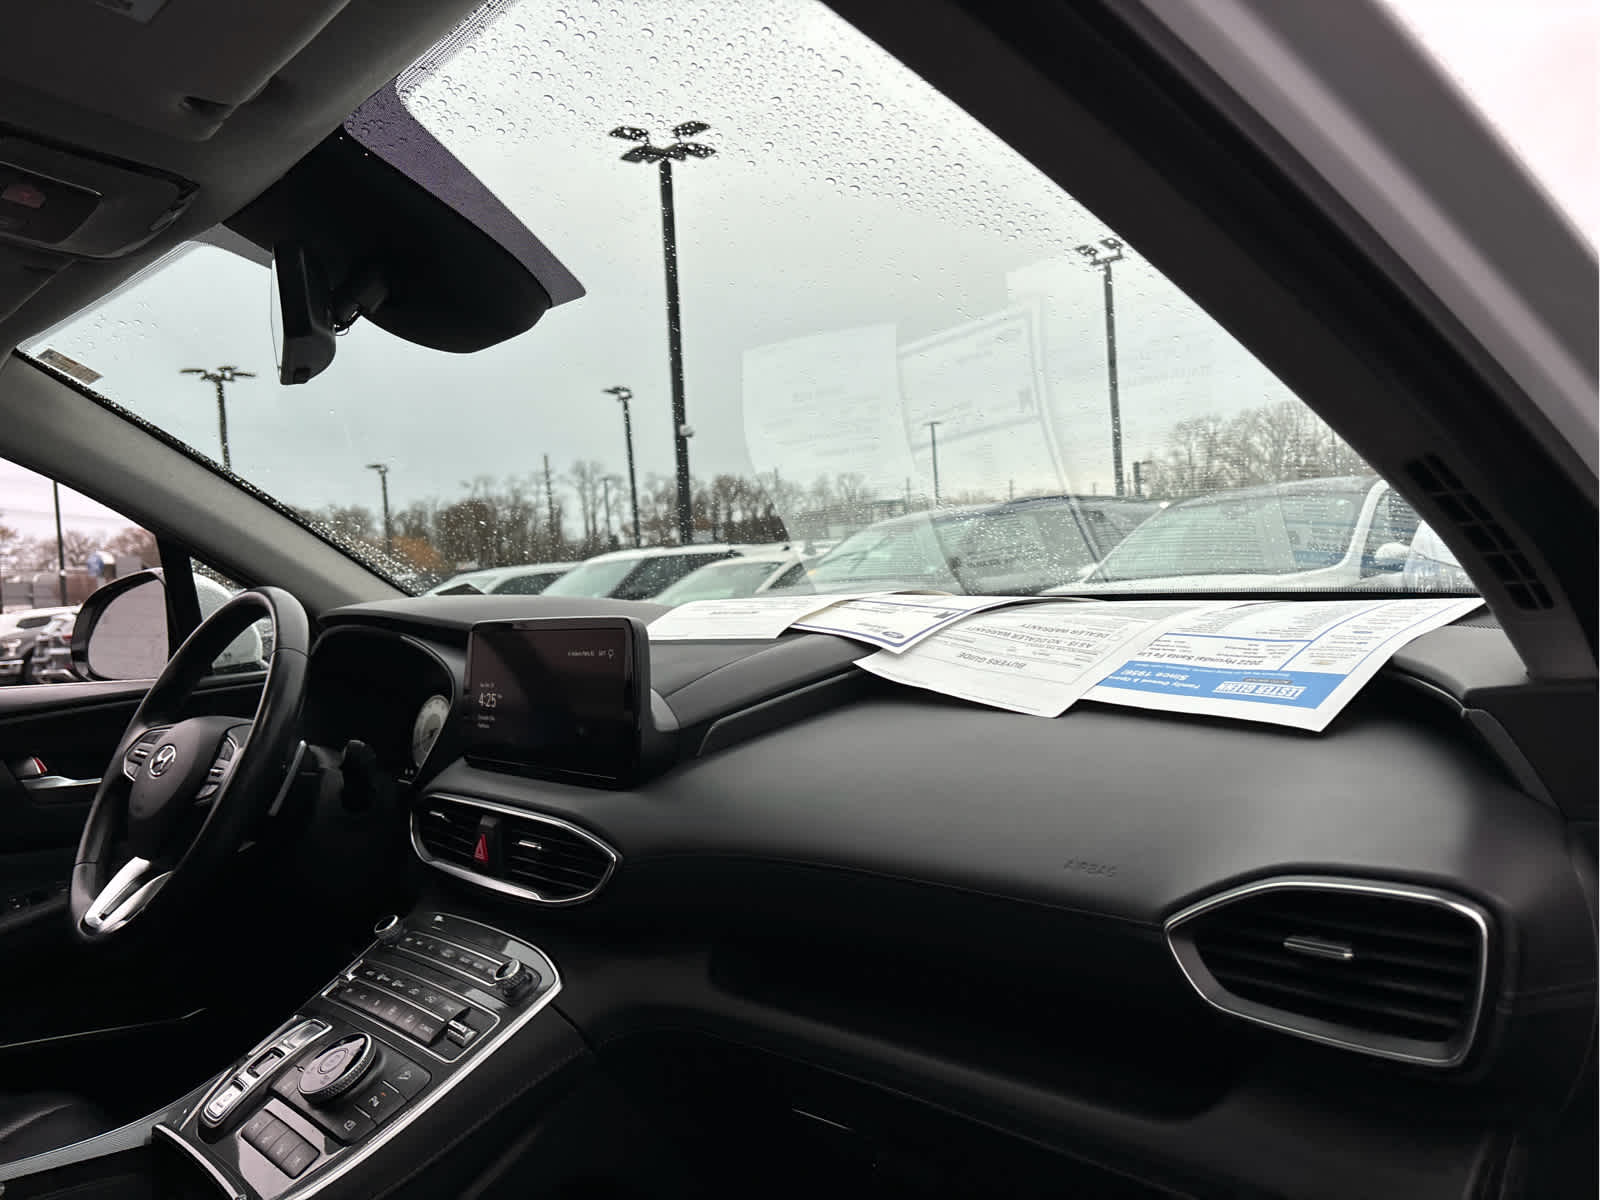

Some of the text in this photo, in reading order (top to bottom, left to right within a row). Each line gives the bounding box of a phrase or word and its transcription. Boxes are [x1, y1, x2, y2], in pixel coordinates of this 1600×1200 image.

[965, 626, 1011, 638] WARRANTY
[1011, 632, 1048, 643] DEALER
[956, 651, 1027, 670] BUYERS GUIDE
[1165, 652, 1195, 662] Santa
[1194, 655, 1237, 665] Hyundai
[1155, 671, 1190, 681] Since
[1255, 684, 1304, 699] LESTER
[478, 692, 497, 708] 4:25
